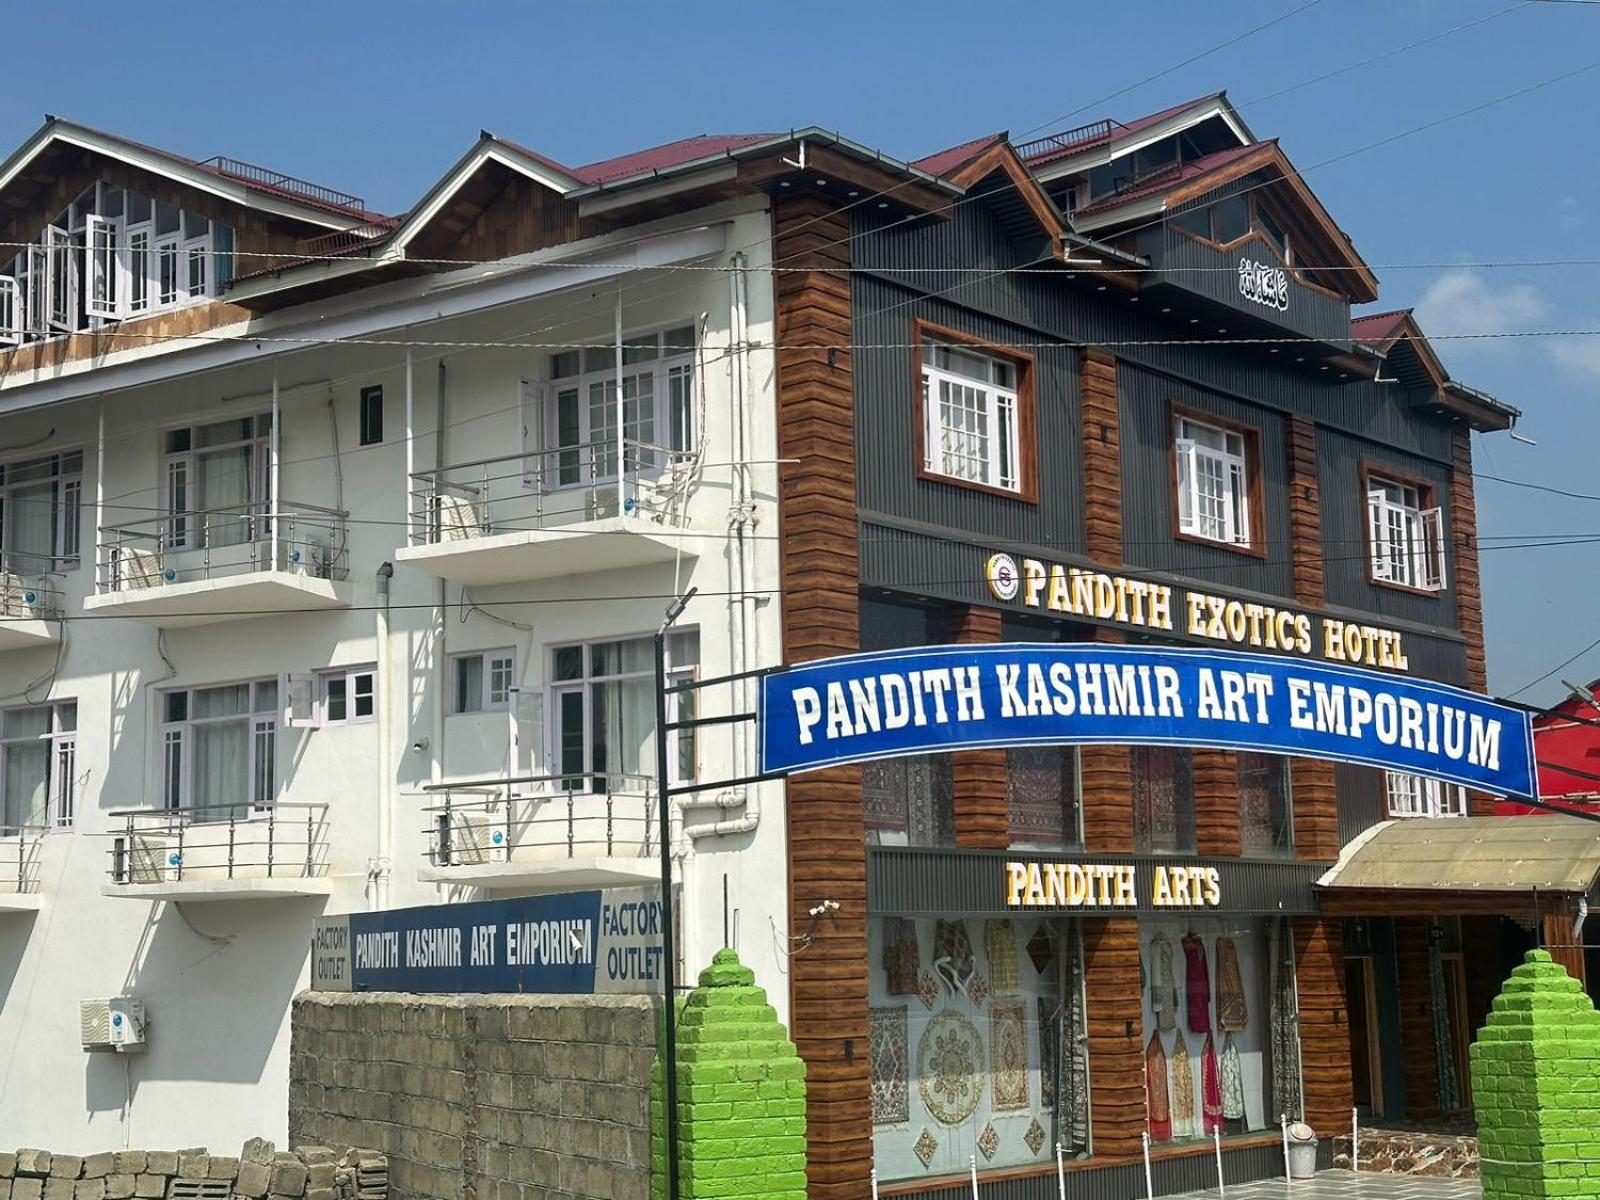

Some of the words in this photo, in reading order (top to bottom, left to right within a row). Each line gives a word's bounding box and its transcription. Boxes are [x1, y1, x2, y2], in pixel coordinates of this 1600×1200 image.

[1023, 558, 1173, 630] PANDITH
[1186, 592, 1312, 654] EXOTICS
[1323, 618, 1409, 671] HOTEL
[791, 665, 986, 745] PANDITH
[995, 662, 1184, 718] KASHMIR
[1198, 667, 1274, 725] ART
[1287, 677, 1501, 772] EMPORIUM
[1006, 862, 1137, 906] PANDITH
[1152, 865, 1221, 906] ARTS
[316, 926, 348, 950] FACTORY
[355, 931, 399, 969] PANDITH
[406, 927, 461, 968] KASHMIR
[470, 924, 497, 967] ART
[506, 918, 592, 967] EMPORIUM
[318, 957, 345, 980] OUTLET
[607, 946, 663, 980] OUTLET
